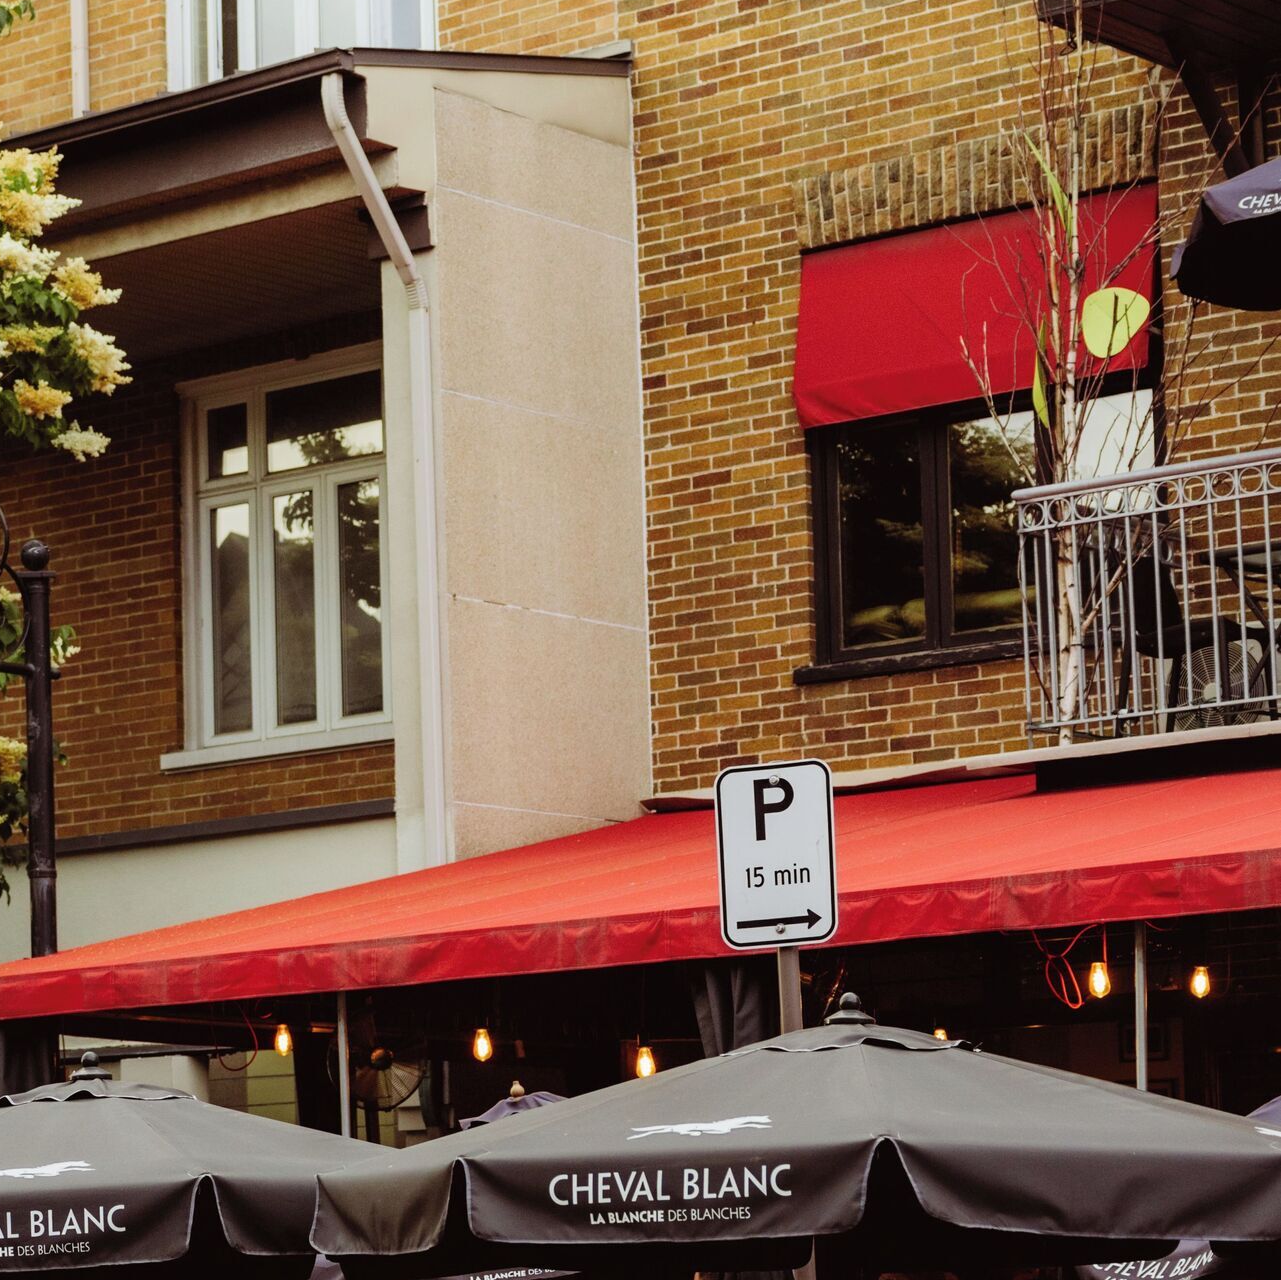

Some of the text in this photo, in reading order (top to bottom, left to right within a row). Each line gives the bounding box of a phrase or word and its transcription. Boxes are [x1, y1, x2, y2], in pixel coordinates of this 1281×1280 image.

[753, 777, 794, 841] P
[745, 862, 811, 889] 15 min
[548, 1163, 792, 1206] CHEVAL BLANC
[30, 1204, 126, 1238] BLANC
[589, 1206, 751, 1225] LA BLANCHE DES BLANCHES
[17, 1244, 35, 1256] DES
[37, 1241, 90, 1256] BLANCHES
